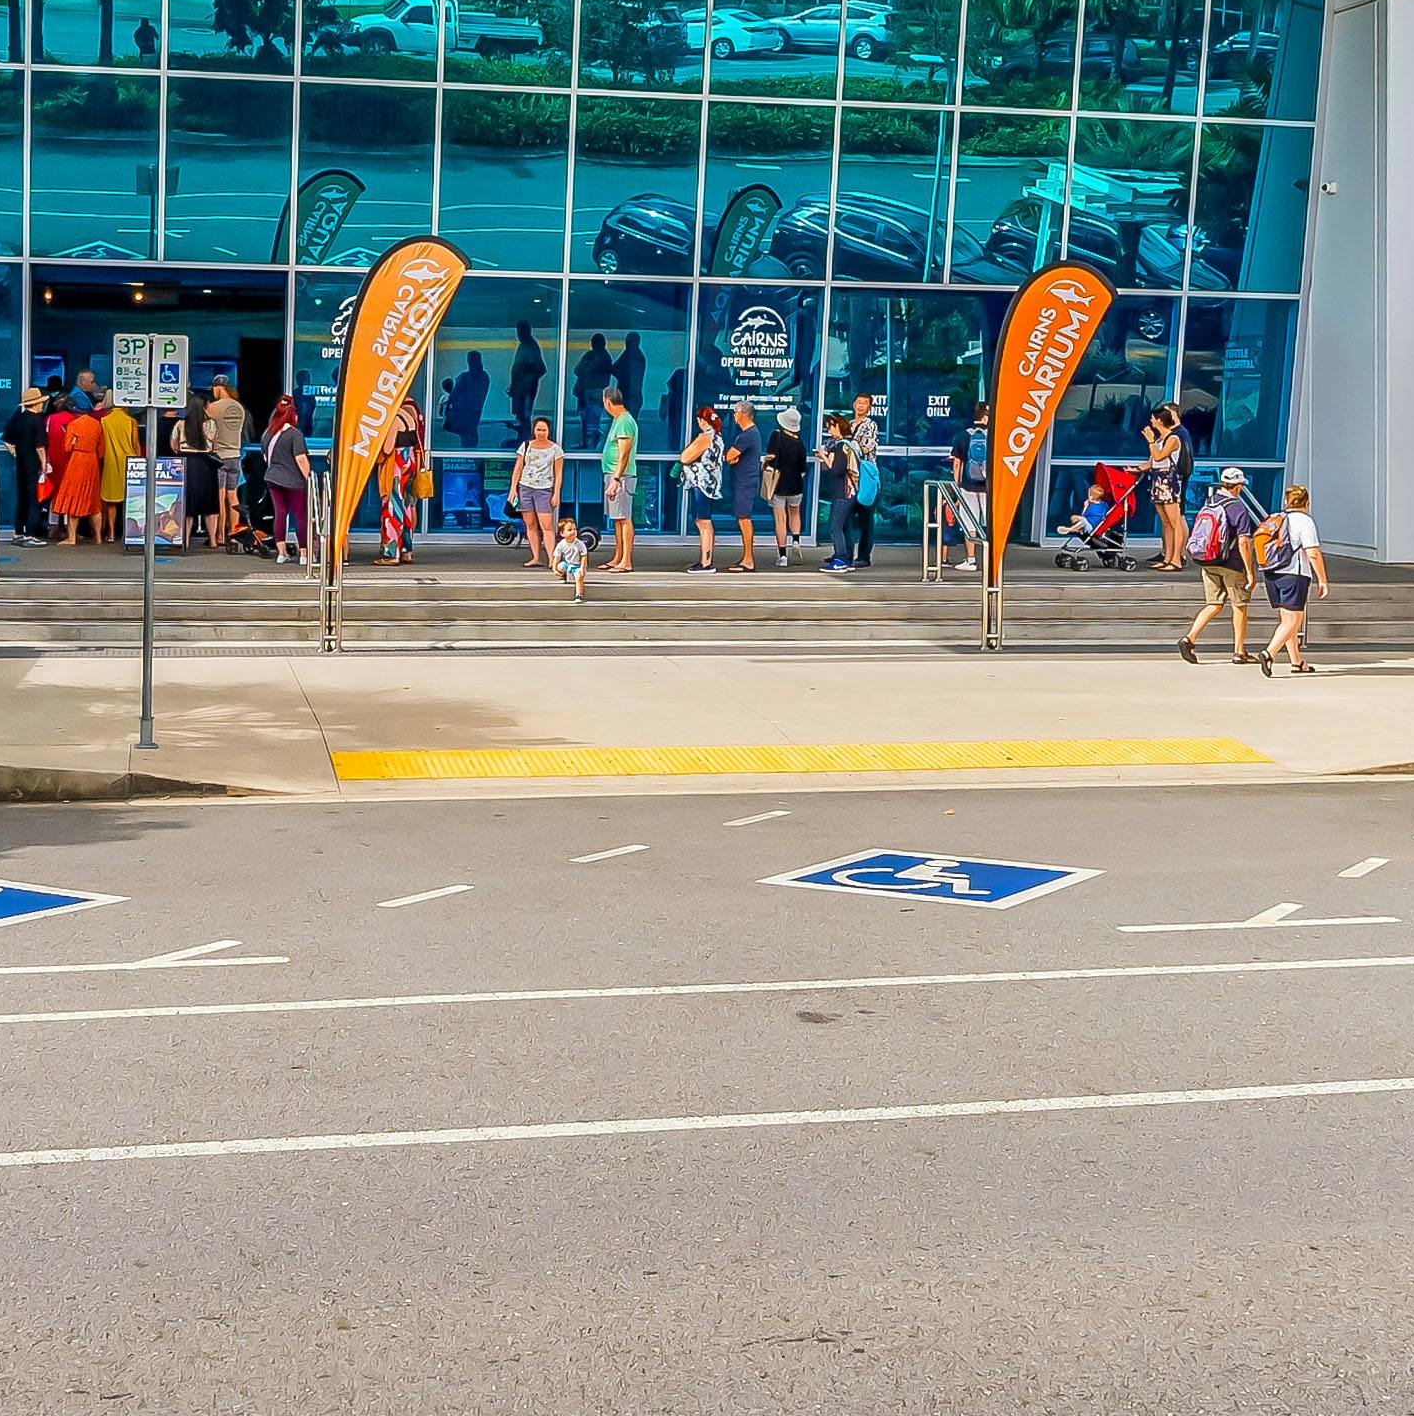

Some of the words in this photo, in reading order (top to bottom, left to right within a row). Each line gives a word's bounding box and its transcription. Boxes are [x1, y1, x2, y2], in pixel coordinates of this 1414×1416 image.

[731, 331, 788, 347] CAIRNS
[1018, 307, 1057, 376] CAIRNS
[118, 338, 146, 355] 3P
[164, 343, 177, 359] P
[731, 347, 784, 355] AQUARIUM
[721, 357, 745, 367] OPEN
[747, 357, 793, 369] EVERYDAY
[1002, 308, 1090, 477] AQUARIUM
[870, 395, 887, 405] XIT
[928, 395, 950, 406] EXIT
[927, 407, 950, 417] ONLY
[127, 471, 172, 479] HOSTAL
